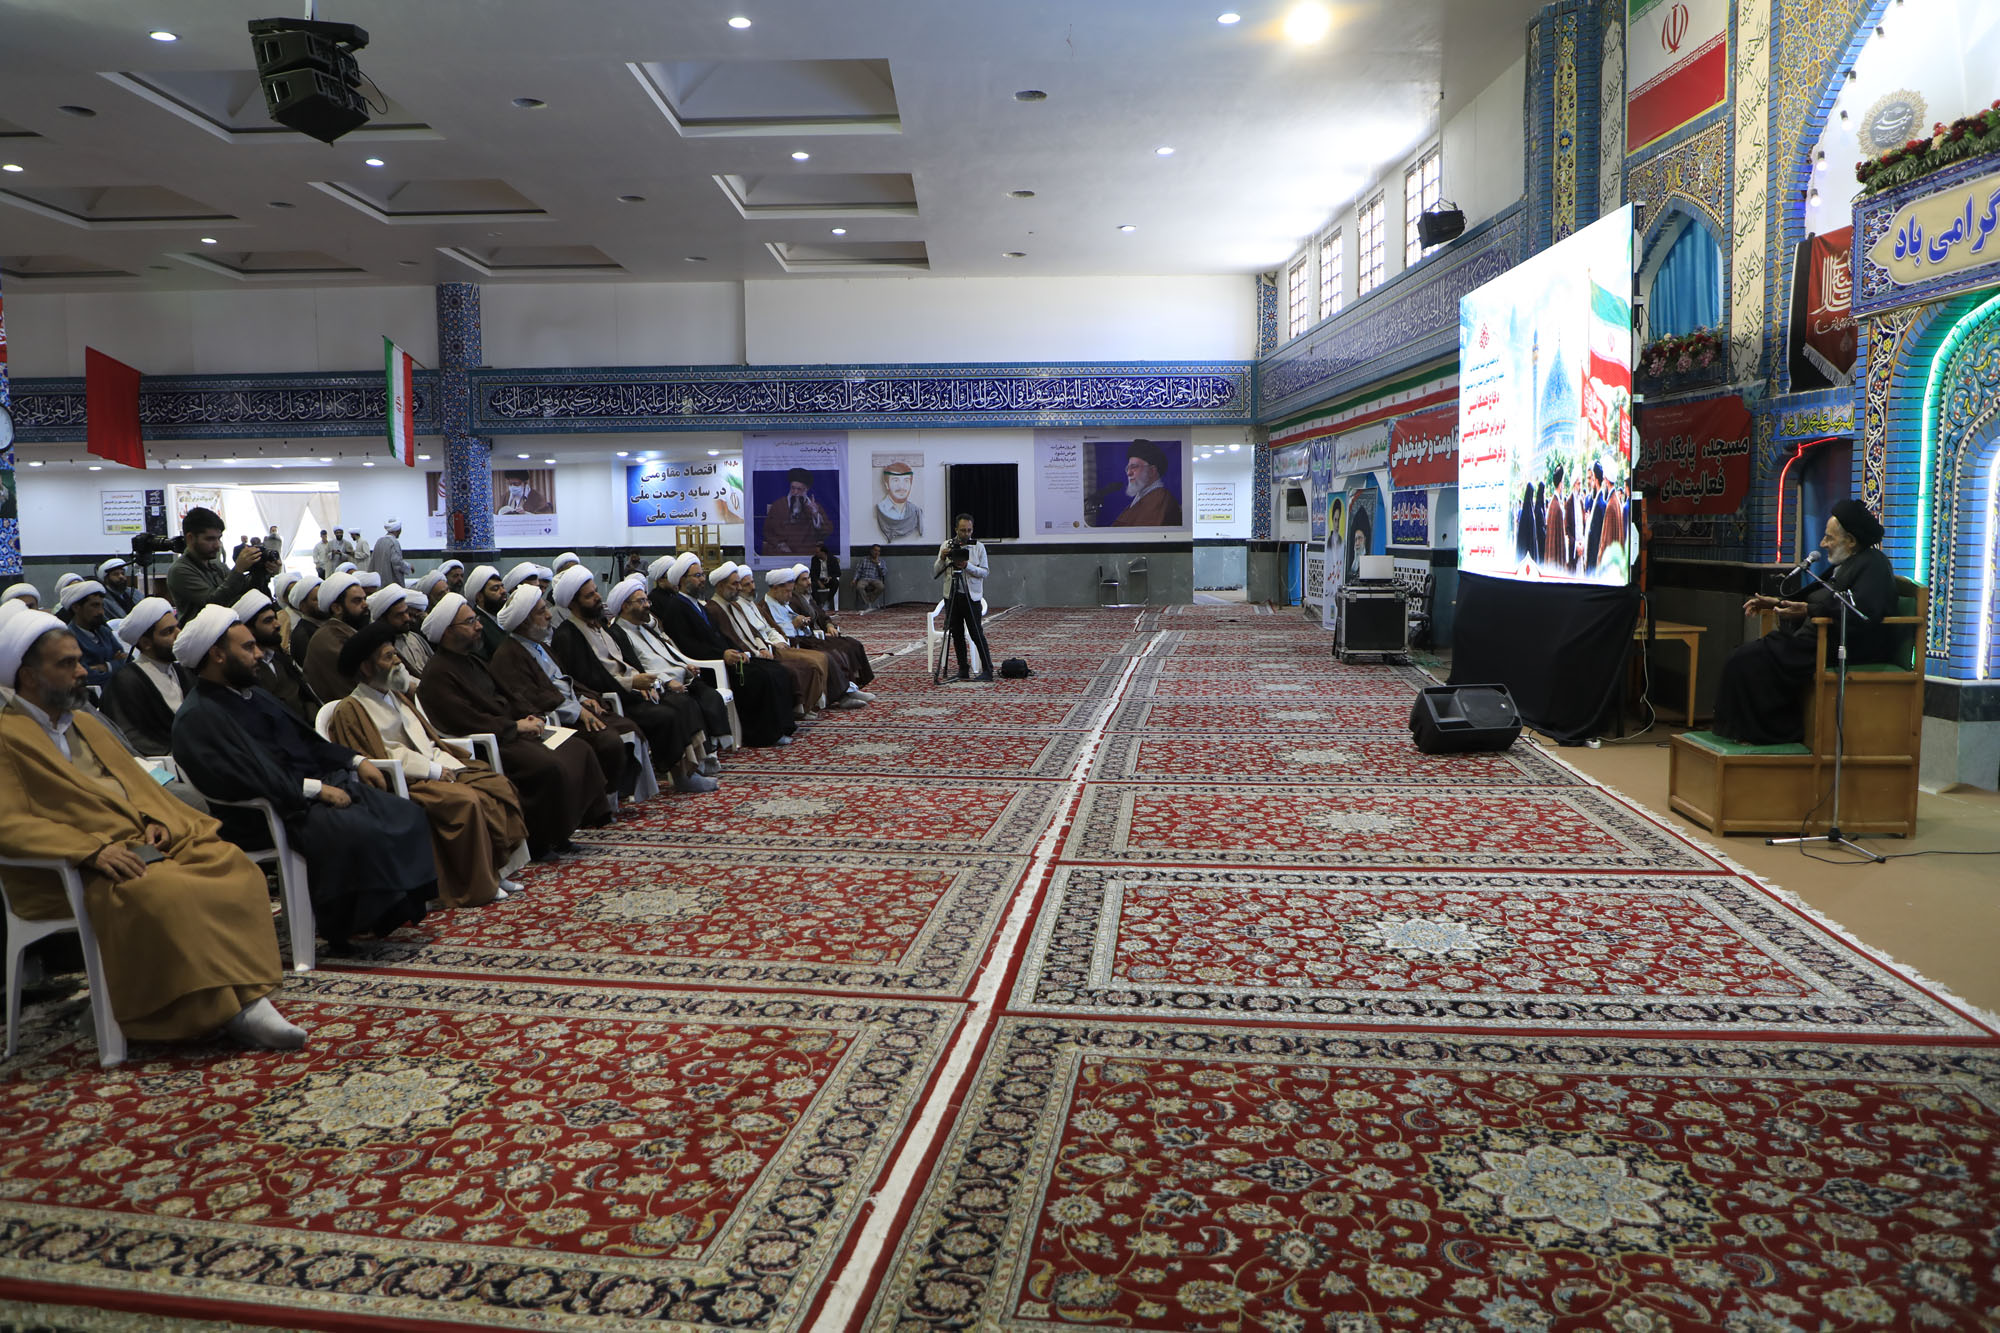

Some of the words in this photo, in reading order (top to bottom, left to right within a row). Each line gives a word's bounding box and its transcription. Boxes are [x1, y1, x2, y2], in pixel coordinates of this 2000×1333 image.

[1894, 213, 1923, 267] باد
[1391, 432, 1428, 468] خونخواهی
[1428, 438, 1434, 463] و
[1664, 434, 1697, 473] پایگاه
[641, 467, 681, 482] مقاومتی
[683, 463, 717, 477] اقتصاد
[652, 489, 685, 501] وحدت
[688, 486, 710, 500] سایه
[713, 486, 727, 499] در
[669, 508, 698, 520] امنیت
[701, 511, 707, 521] و
